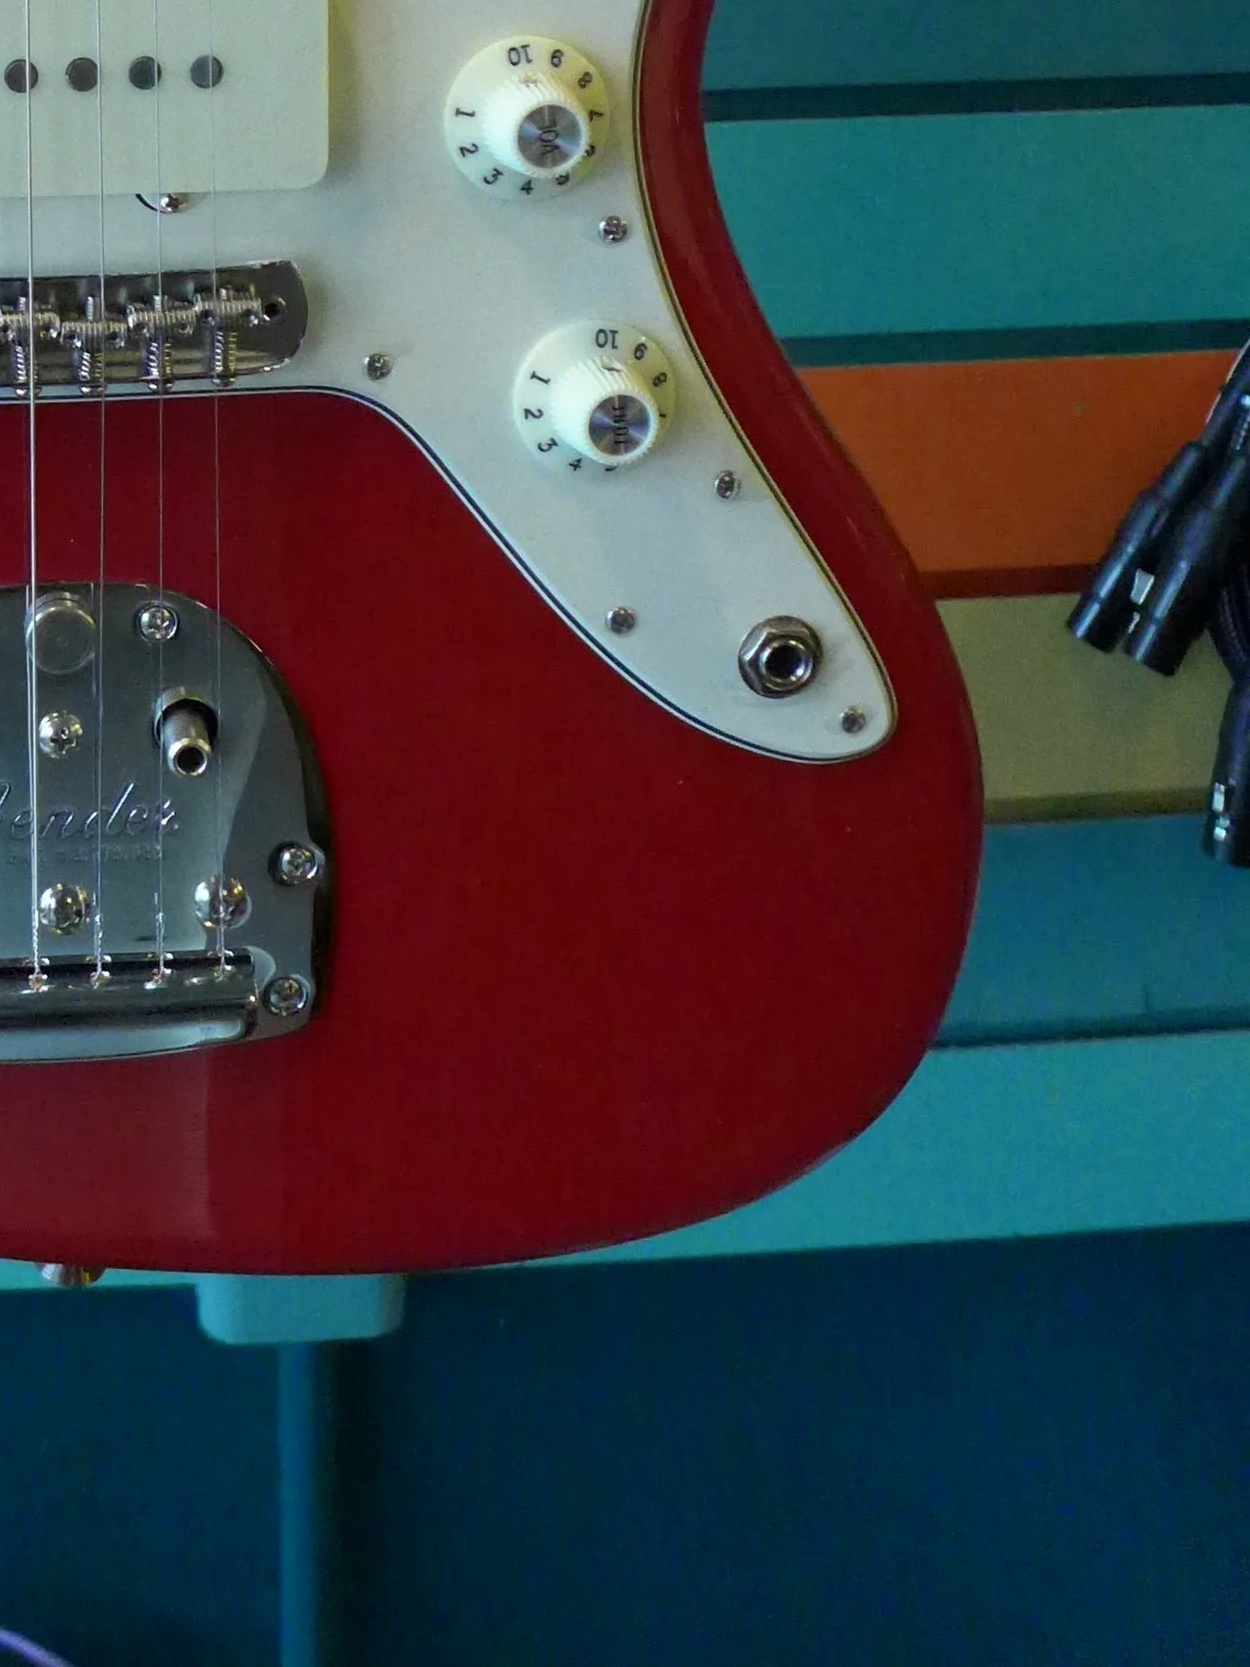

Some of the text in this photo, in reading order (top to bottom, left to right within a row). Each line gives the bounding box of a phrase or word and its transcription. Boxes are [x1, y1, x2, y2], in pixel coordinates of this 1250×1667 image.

[508, 44, 533, 67] 10
[550, 49, 565, 68] 9
[577, 71, 593, 89] 8
[455, 107, 476, 118] 1
[538, 117, 561, 156] VOL
[459, 143, 479, 158] 2
[483, 168, 504, 185] 3
[520, 180, 534, 195] 4
[595, 328, 618, 349] 10
[633, 342, 648, 360] 9
[529, 370, 550, 385] 1
[523, 408, 543, 420] 2
[537, 437, 559, 453] 3
[568, 458, 583, 472] 4
